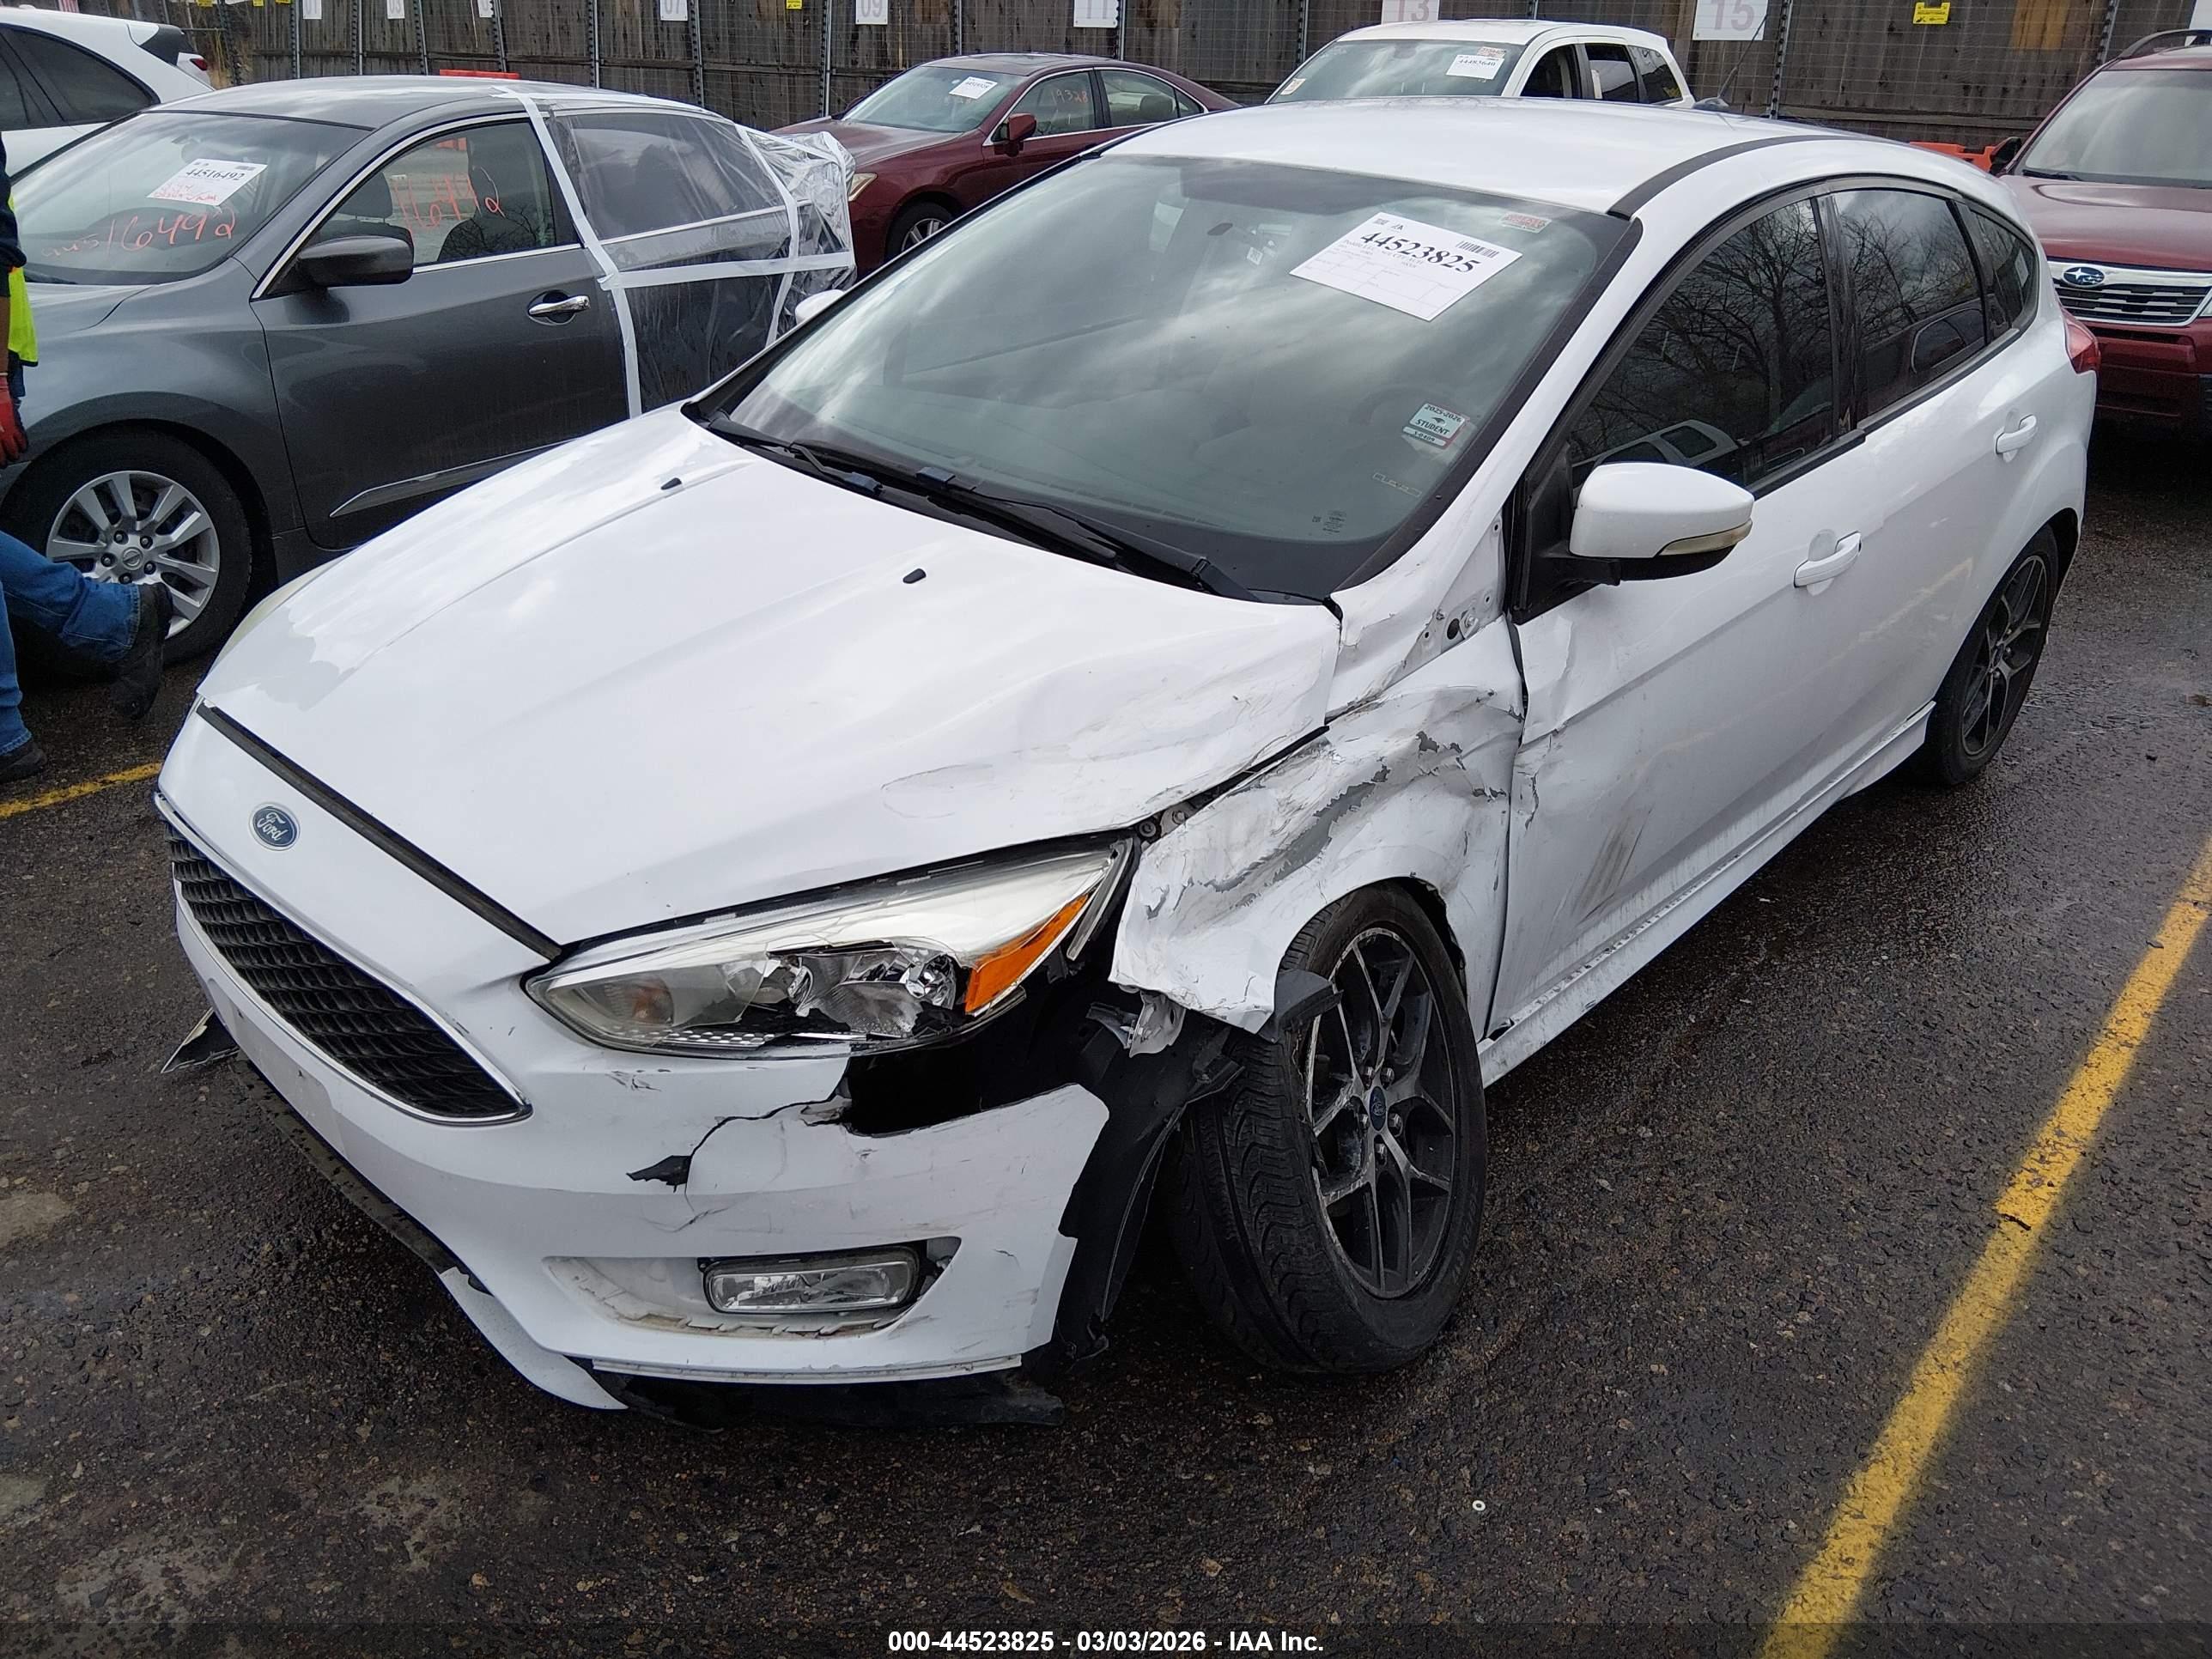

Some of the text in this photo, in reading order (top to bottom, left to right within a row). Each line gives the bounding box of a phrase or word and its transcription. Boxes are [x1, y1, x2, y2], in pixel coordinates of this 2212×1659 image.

[1711, 0, 1755, 31] 15
[1359, 231, 1482, 273] 44523825
[1415, 419, 1450, 434] STUDENT
[257, 811, 289, 841] Ford
